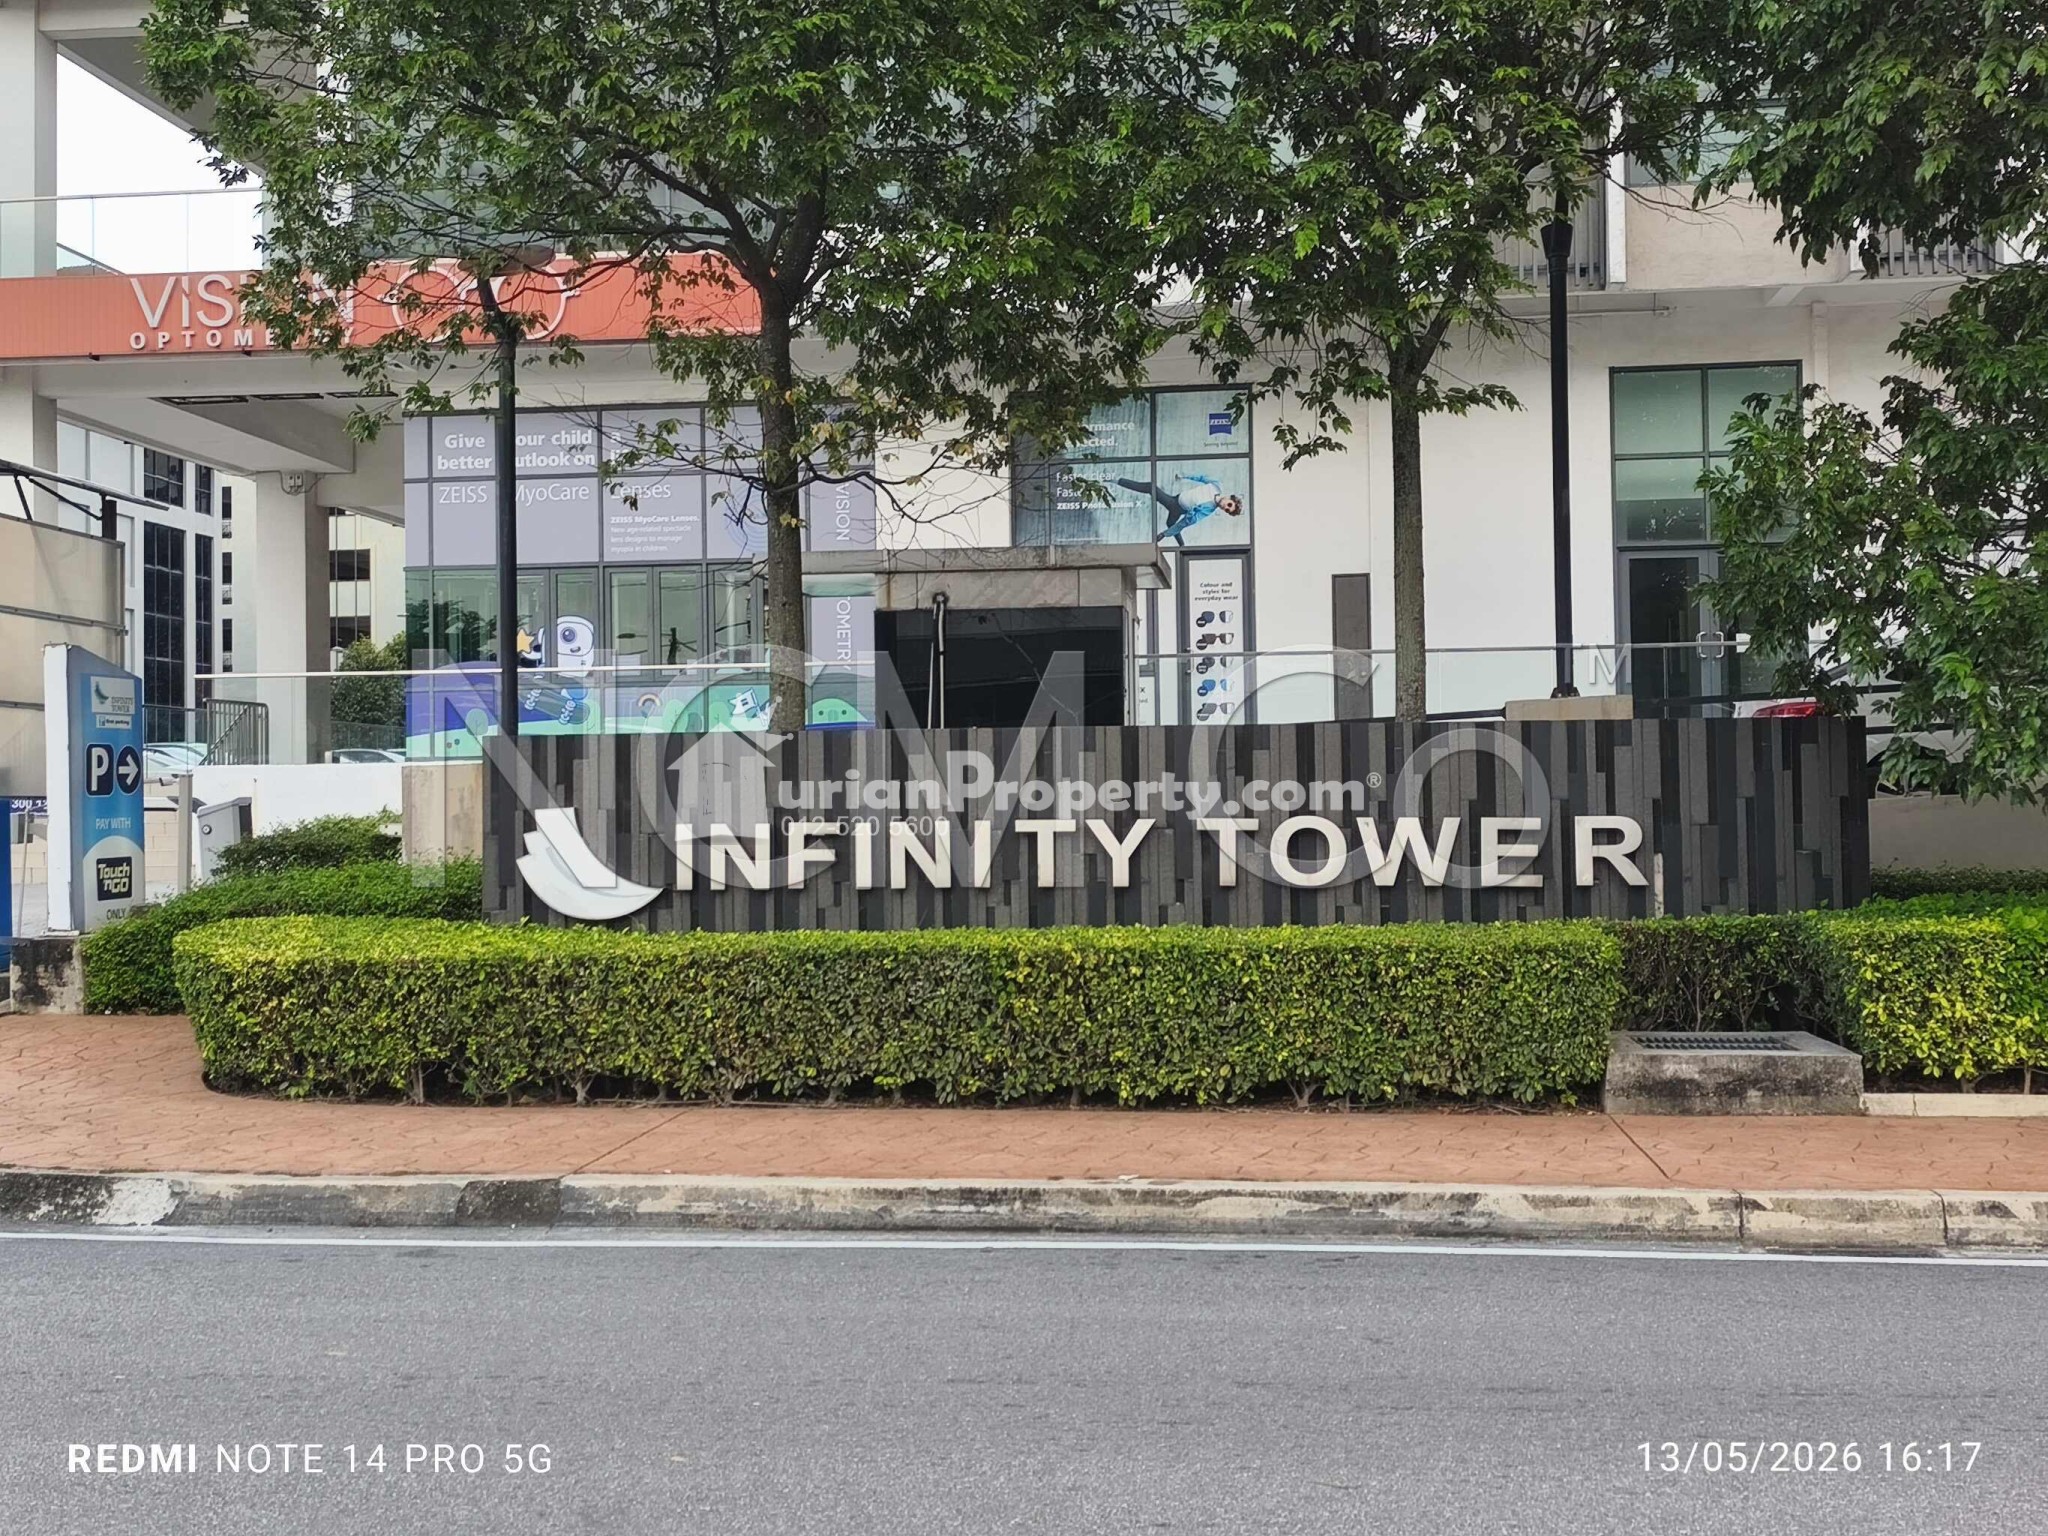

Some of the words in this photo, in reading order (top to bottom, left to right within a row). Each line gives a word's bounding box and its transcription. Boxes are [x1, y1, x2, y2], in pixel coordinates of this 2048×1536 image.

[130, 328, 355, 350] OPTOMEY
[444, 434, 486, 449] Give
[515, 434, 545, 447] our
[550, 430, 593, 445] child
[437, 455, 493, 471] better
[515, 452, 569, 468] utlook
[573, 453, 596, 467] on
[439, 485, 488, 504] ZEISS
[1056, 487, 1085, 498] Faste
[835, 483, 851, 541] VISION
[1056, 501, 1081, 510] ZEISS
[1082, 500, 1134, 510] Photousion
[610, 516, 634, 524] ZEISS
[836, 596, 851, 671] OMETR
[91, 747, 109, 791] P
[96, 817, 109, 830] PAY
[111, 817, 131, 829] WITH
[675, 816, 1157, 891] INFINITY
[1196, 815, 1650, 888] TOWER
[98, 862, 131, 880] Touch
[106, 906, 127, 920] ONLY
